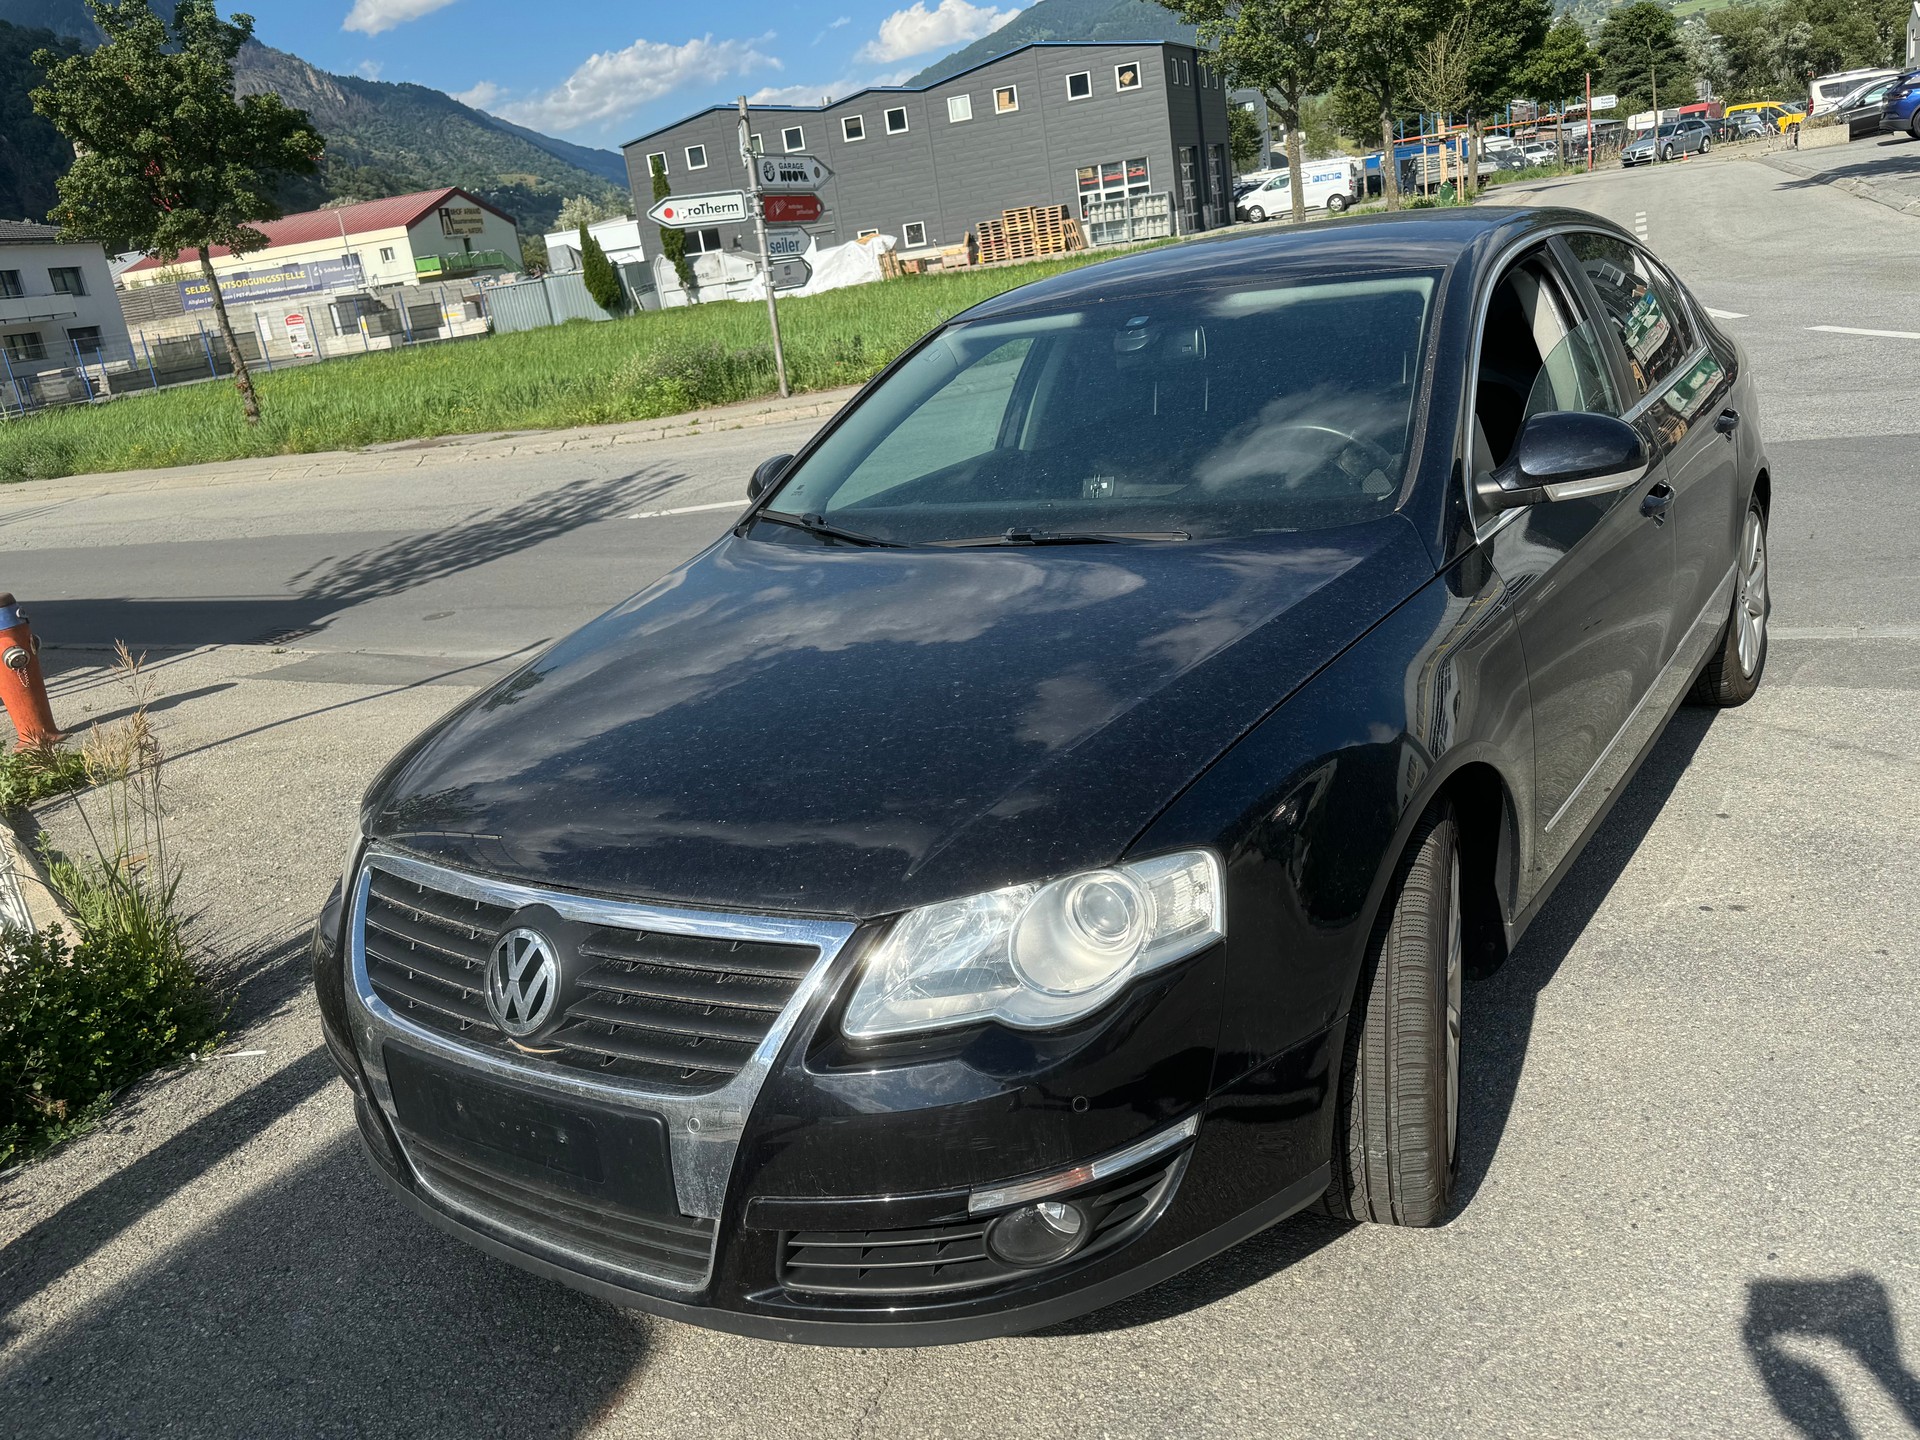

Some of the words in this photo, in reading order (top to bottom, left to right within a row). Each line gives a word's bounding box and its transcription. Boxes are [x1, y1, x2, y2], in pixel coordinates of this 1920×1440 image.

[778, 162, 805, 170] GARAGE
[779, 170, 810, 182] NUOVA
[770, 237, 801, 253] seiler
[184, 270, 306, 295] SELBSNTSORGUNGSSTELLE
